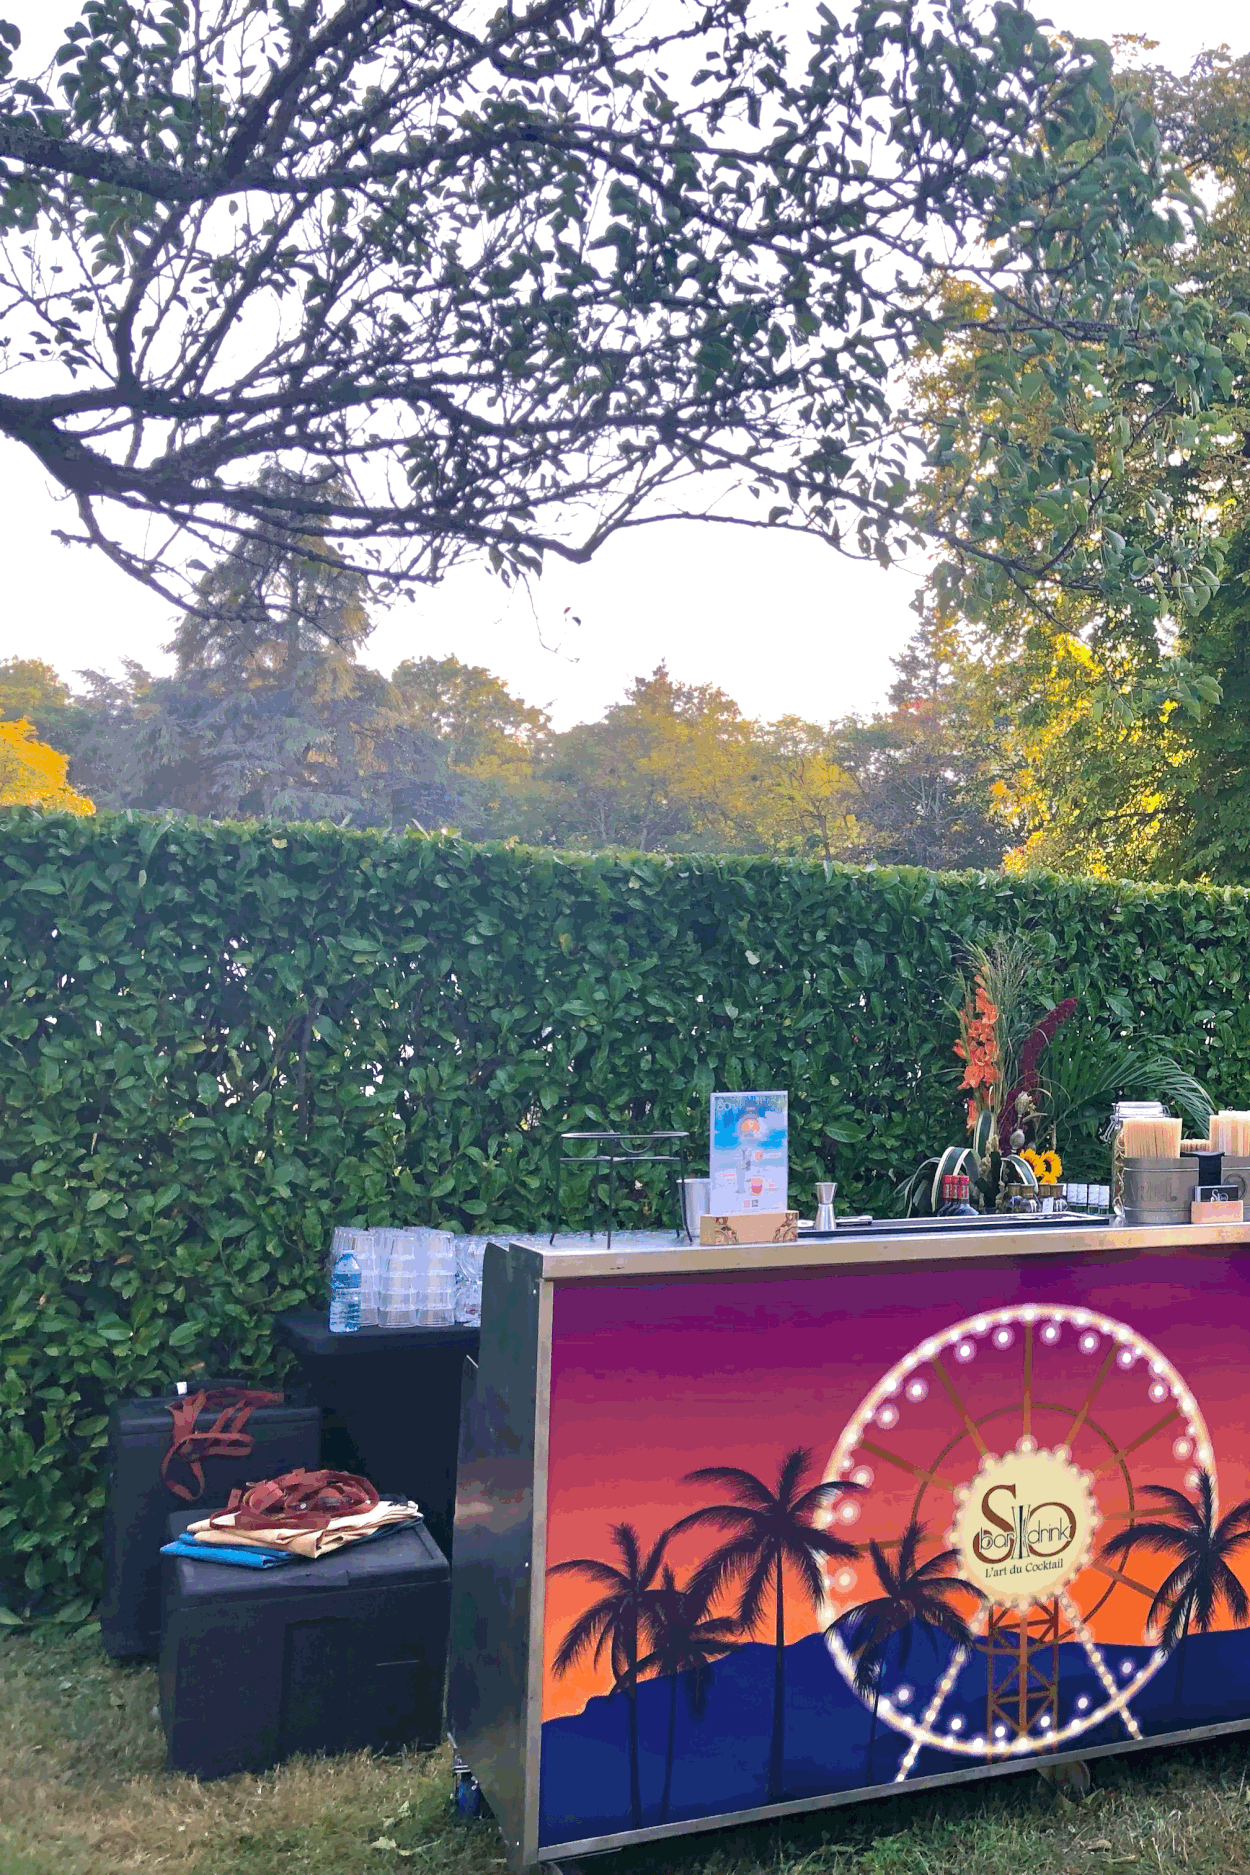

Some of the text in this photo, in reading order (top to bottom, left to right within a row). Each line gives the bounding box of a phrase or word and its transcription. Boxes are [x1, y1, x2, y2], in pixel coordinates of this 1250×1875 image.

[980, 1517, 1069, 1550] bar drink
[985, 1558, 1063, 1578] L'art du Cocktail
